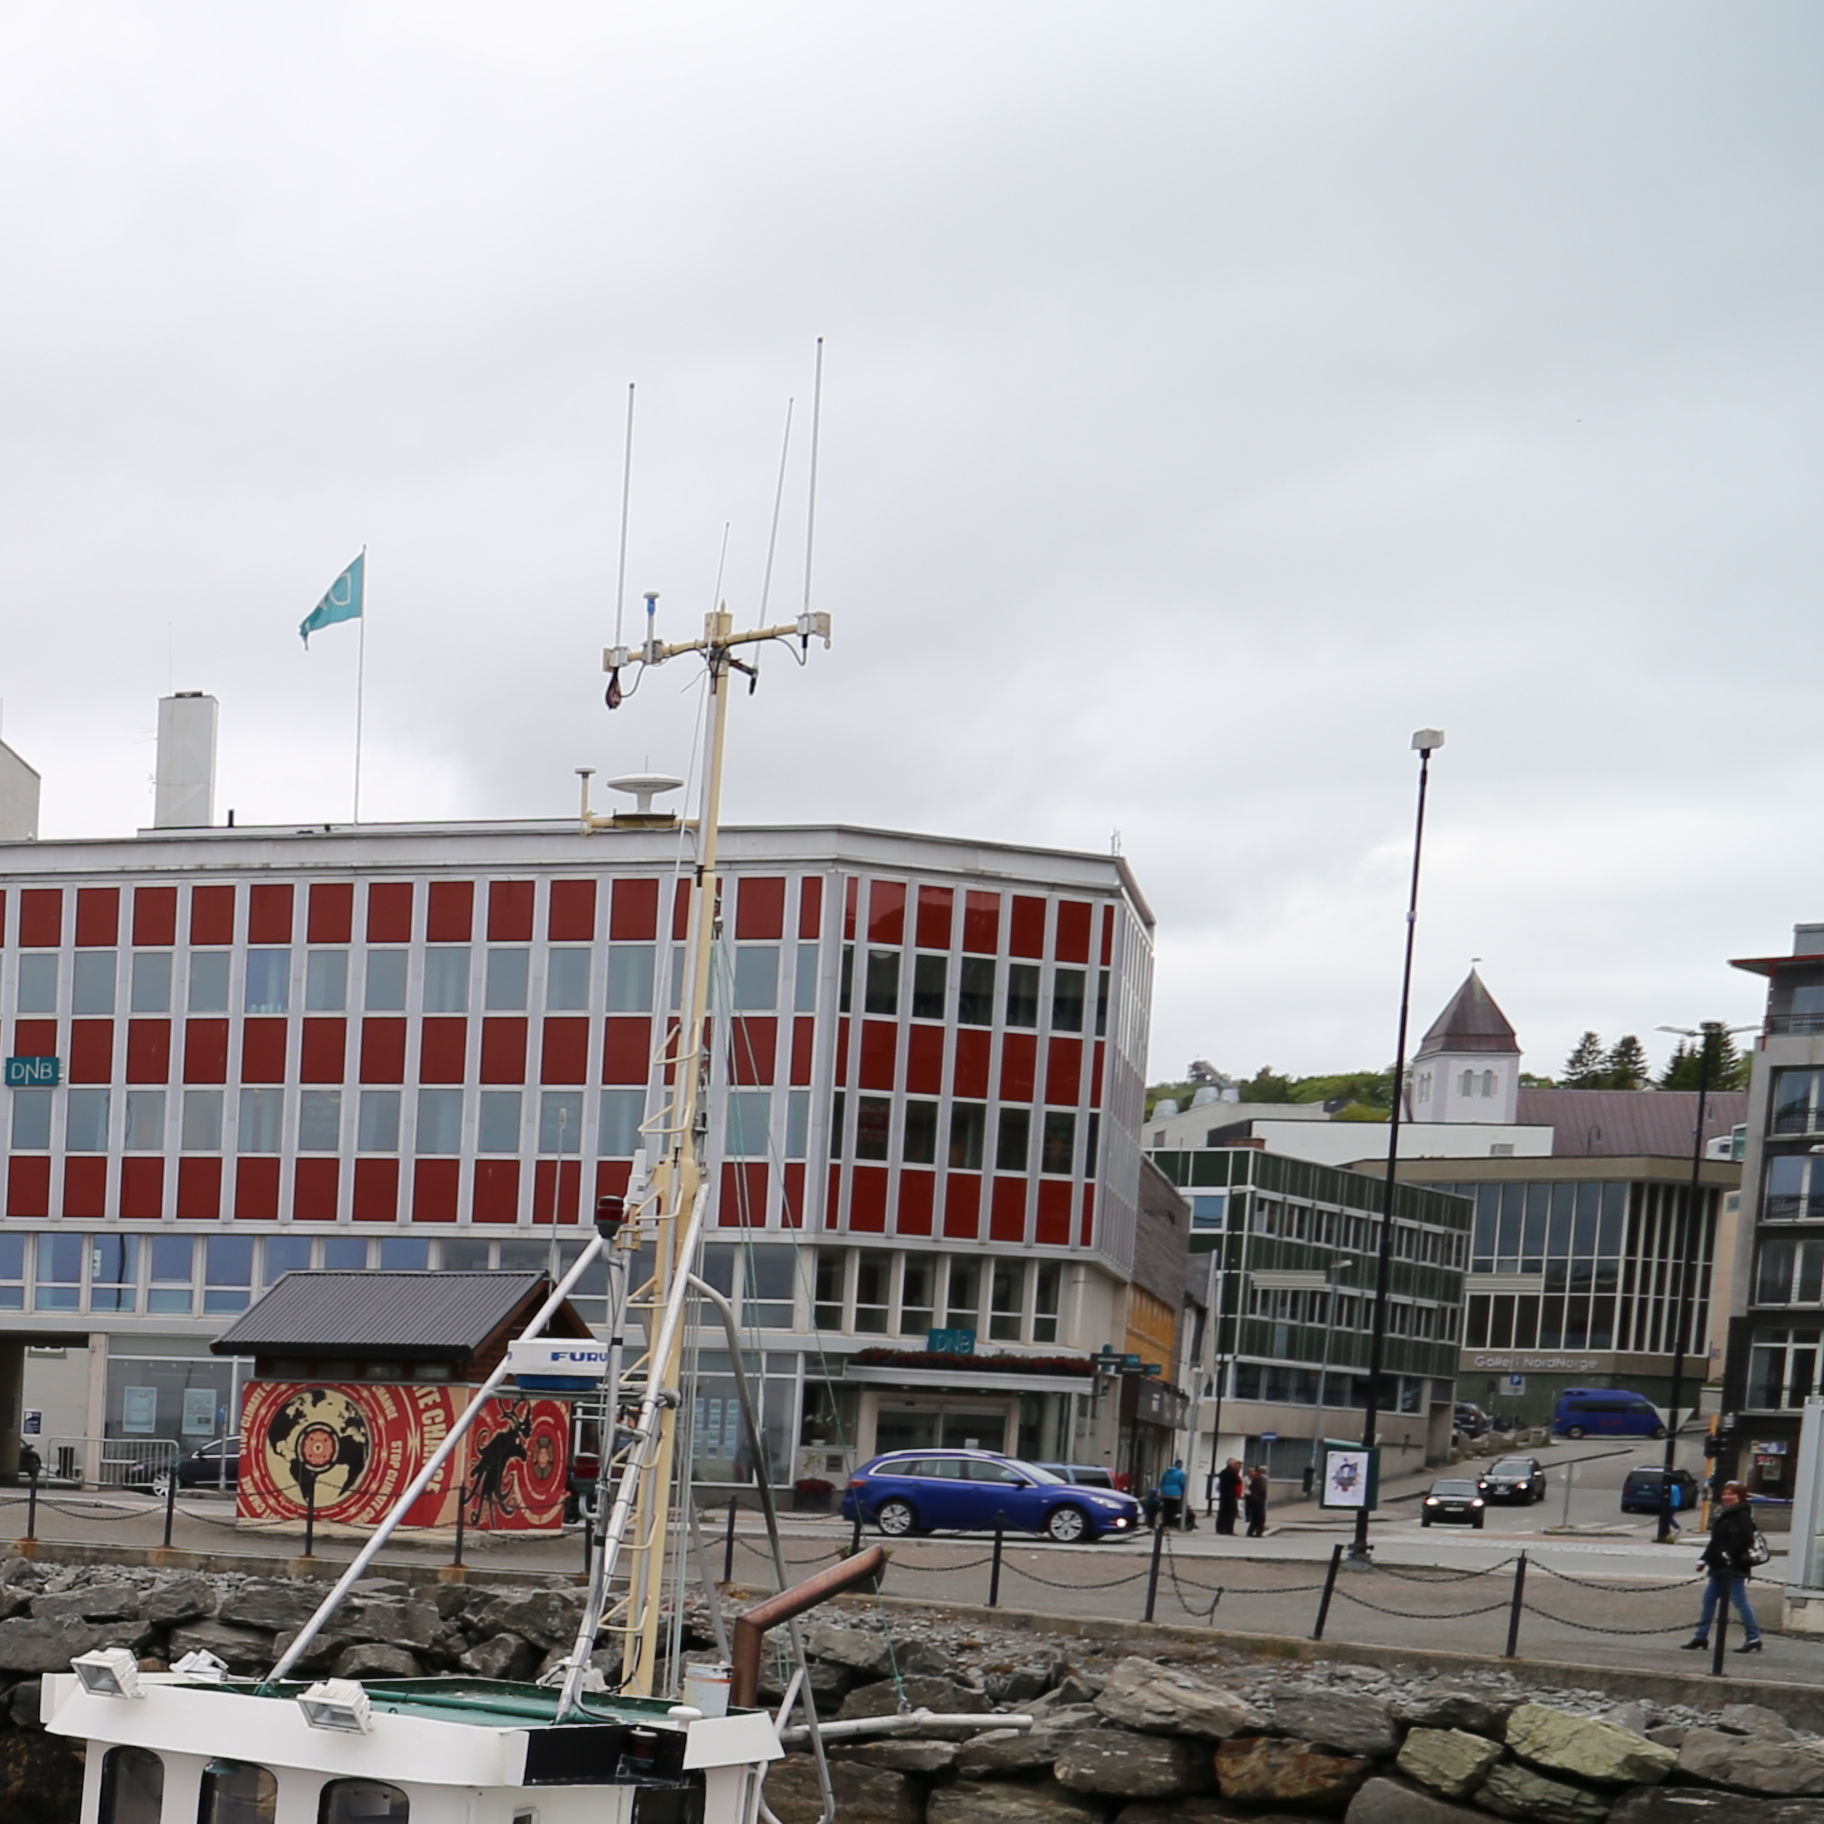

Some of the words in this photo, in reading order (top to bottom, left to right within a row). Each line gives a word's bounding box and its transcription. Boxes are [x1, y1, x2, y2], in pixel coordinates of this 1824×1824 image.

[11, 1056, 53, 1085] DNB
[936, 1330, 971, 1354] DNB
[1474, 1355, 1520, 1369] Galleri
[389, 1439, 403, 1470] STOP
